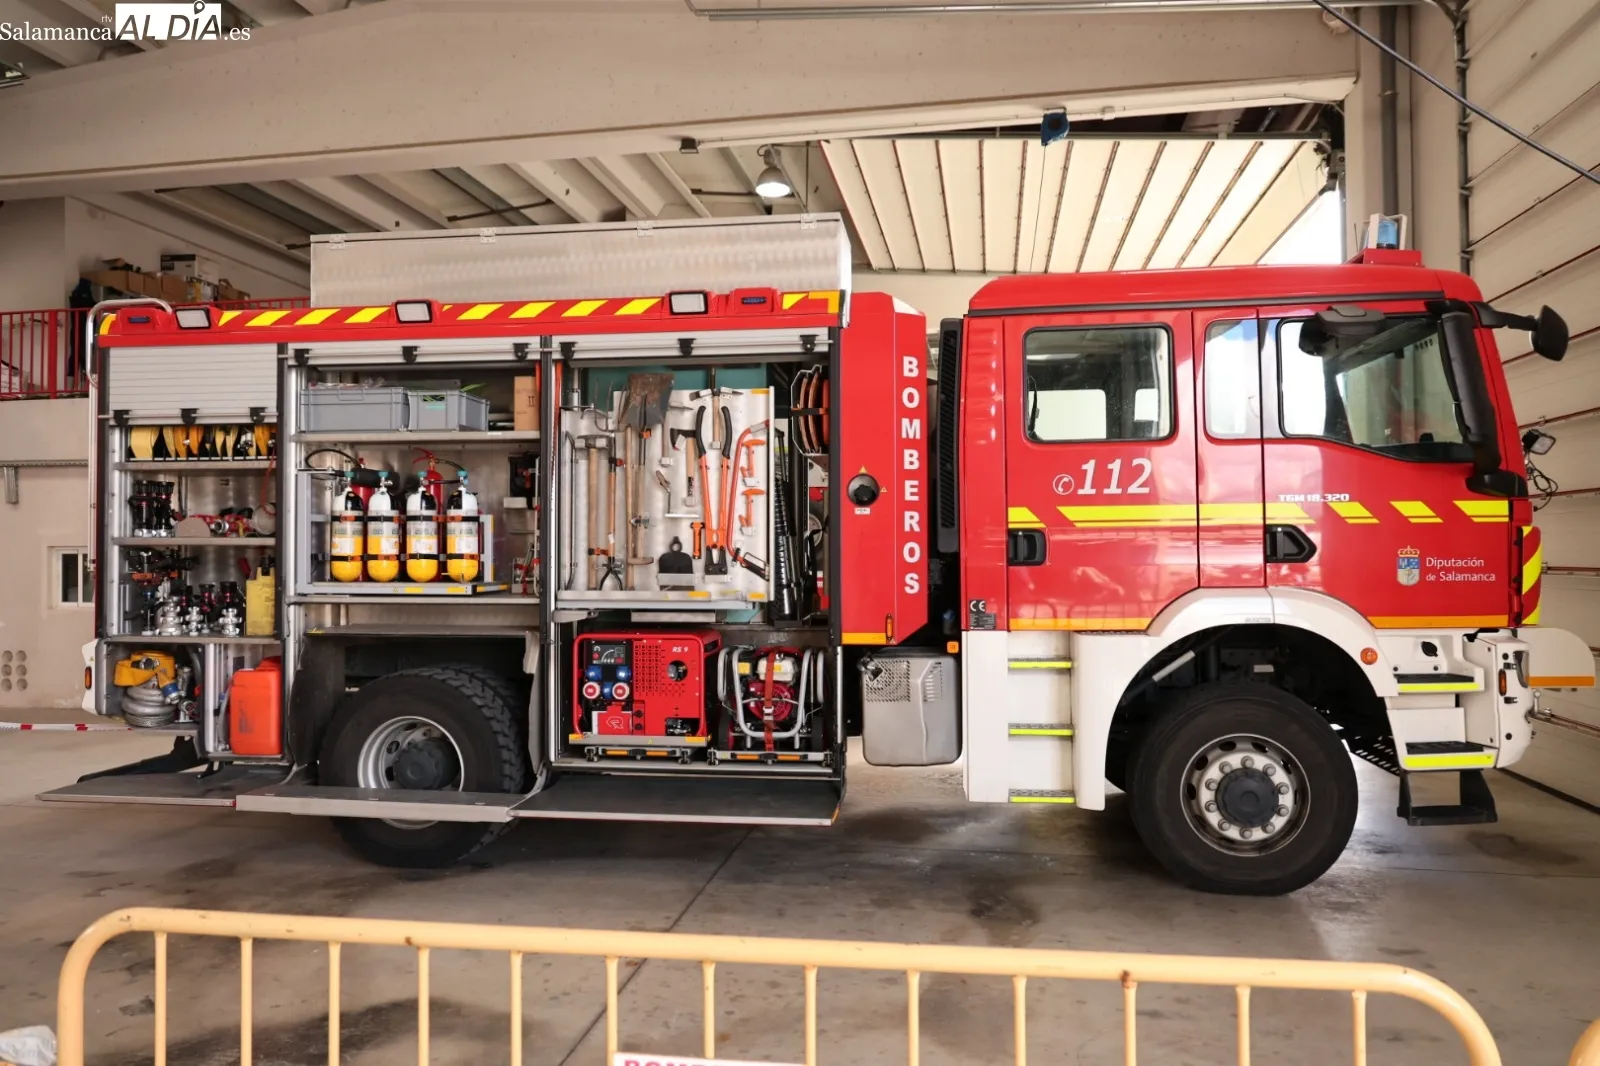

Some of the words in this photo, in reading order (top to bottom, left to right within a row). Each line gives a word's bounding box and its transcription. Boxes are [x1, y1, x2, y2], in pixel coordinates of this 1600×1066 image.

[901, 356, 921, 594] BOMBEROS
[1077, 458, 1153, 495] 112
[1306, 493, 1350, 502] 18.320
[1425, 557, 1485, 570] Diputación
[1425, 573, 1437, 582] de
[1439, 571, 1496, 582] Salamanca
